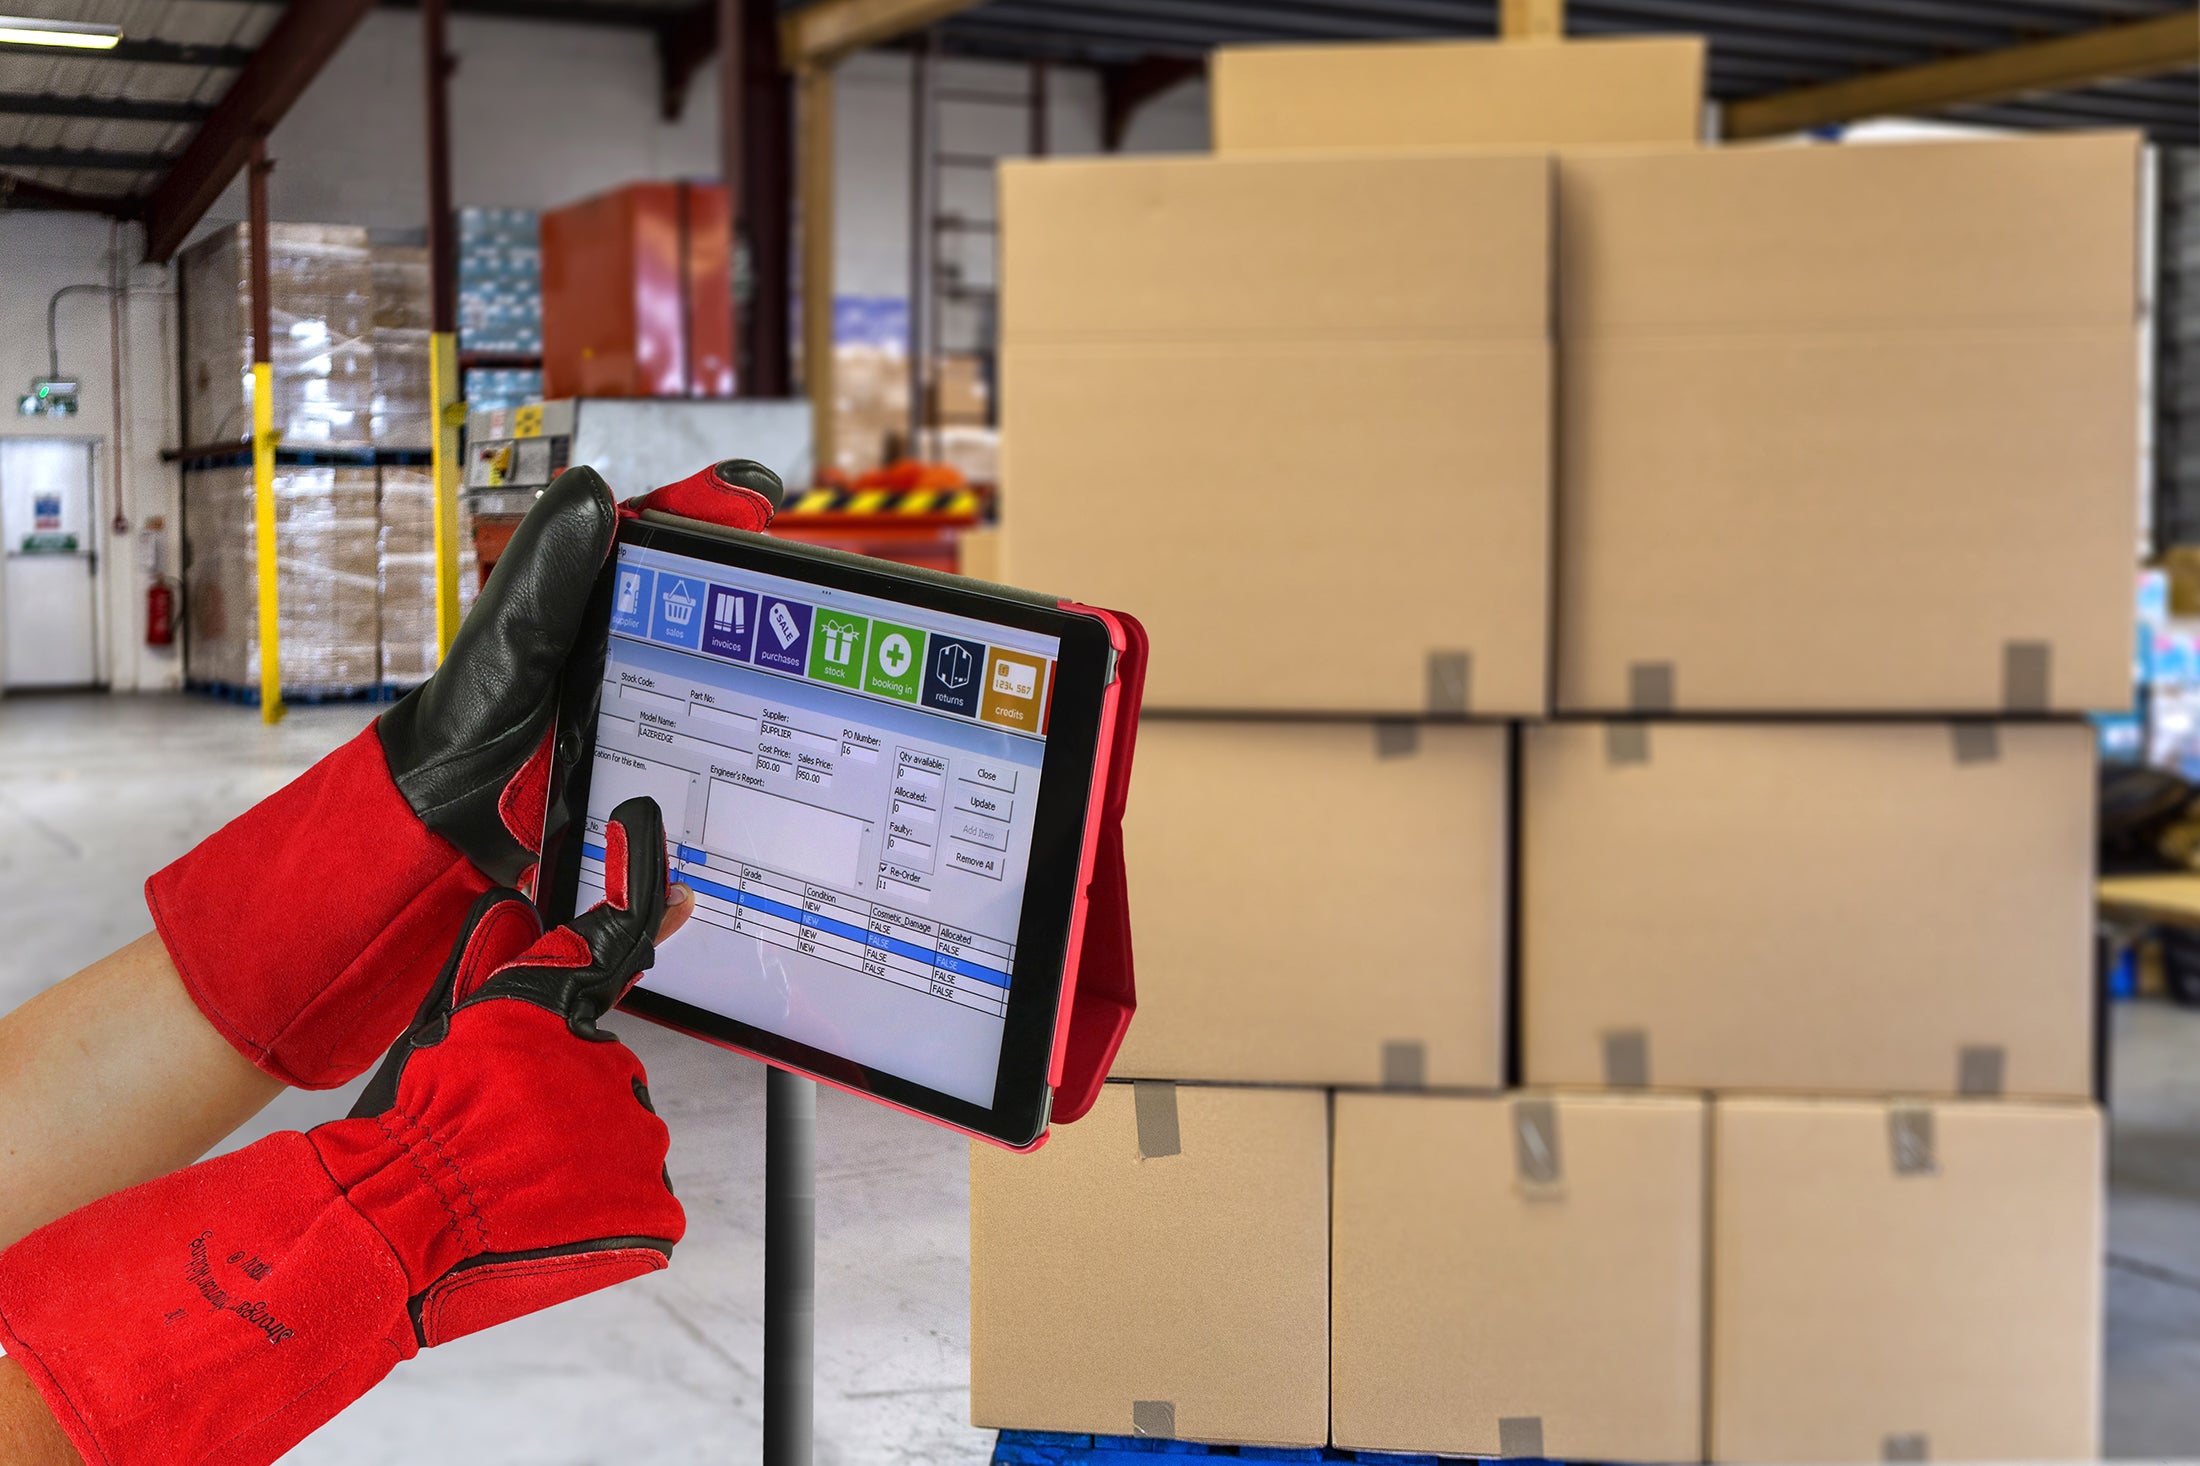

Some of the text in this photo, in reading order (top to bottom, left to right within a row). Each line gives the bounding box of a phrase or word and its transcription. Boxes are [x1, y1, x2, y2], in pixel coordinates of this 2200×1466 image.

[665, 626, 684, 639] sales
[776, 614, 794, 642] SALE
[712, 636, 742, 652] invoices
[761, 650, 800, 667] purchases
[621, 672, 656, 688] Stock Code:
[824, 666, 846, 679] stock
[872, 677, 912, 696] booking in
[995, 680, 1032, 695] 1234 567
[690, 690, 716, 704] Part No:
[935, 692, 964, 707] returns
[640, 711, 676, 728] Model Name:
[762, 708, 790, 723] Supplier:
[995, 705, 1024, 720] credits
[640, 728, 674, 744] LAZEREDGE
[762, 724, 792, 740] SUPPLIER
[842, 728, 882, 747] PO Number:
[758, 742, 792, 759] Cost Price:
[843, 744, 851, 755] 16
[612, 752, 620, 763] for
[622, 756, 632, 766] this
[632, 760, 647, 770] item.
[758, 759, 780, 773] 500.00
[798, 753, 834, 770] Sales Price:
[900, 751, 946, 770] Qty available:
[710, 764, 765, 788] Engineer's Report:
[798, 770, 820, 784] 950.00
[977, 768, 996, 781] Close
[894, 786, 927, 802] Allocated:
[970, 797, 996, 812] Update
[889, 821, 913, 836] Faulty:
[962, 824, 995, 841] Add Item
[680, 862, 686, 870] Y
[956, 852, 994, 871] Remove All
[744, 868, 762, 880] Grade
[890, 866, 922, 883] Re-Order
[878, 880, 887, 890] 11
[806, 887, 836, 903] Condition
[738, 908, 743, 916] B
[805, 900, 821, 912] NEW
[736, 922, 742, 930] A
[803, 914, 820, 926] NEW
[872, 907, 932, 932] Cosmetic_Damage
[801, 928, 818, 940] NEW
[870, 921, 891, 935] FALSE
[868, 935, 889, 949] FALSE
[940, 928, 972, 945] Allocated
[800, 942, 816, 954] NEW
[866, 948, 888, 962] FALSE
[938, 942, 960, 957] FALSE
[864, 963, 886, 977] FALSE
[936, 956, 958, 970] FALSE
[934, 970, 956, 984] FALSE
[932, 984, 954, 999] FALSE
